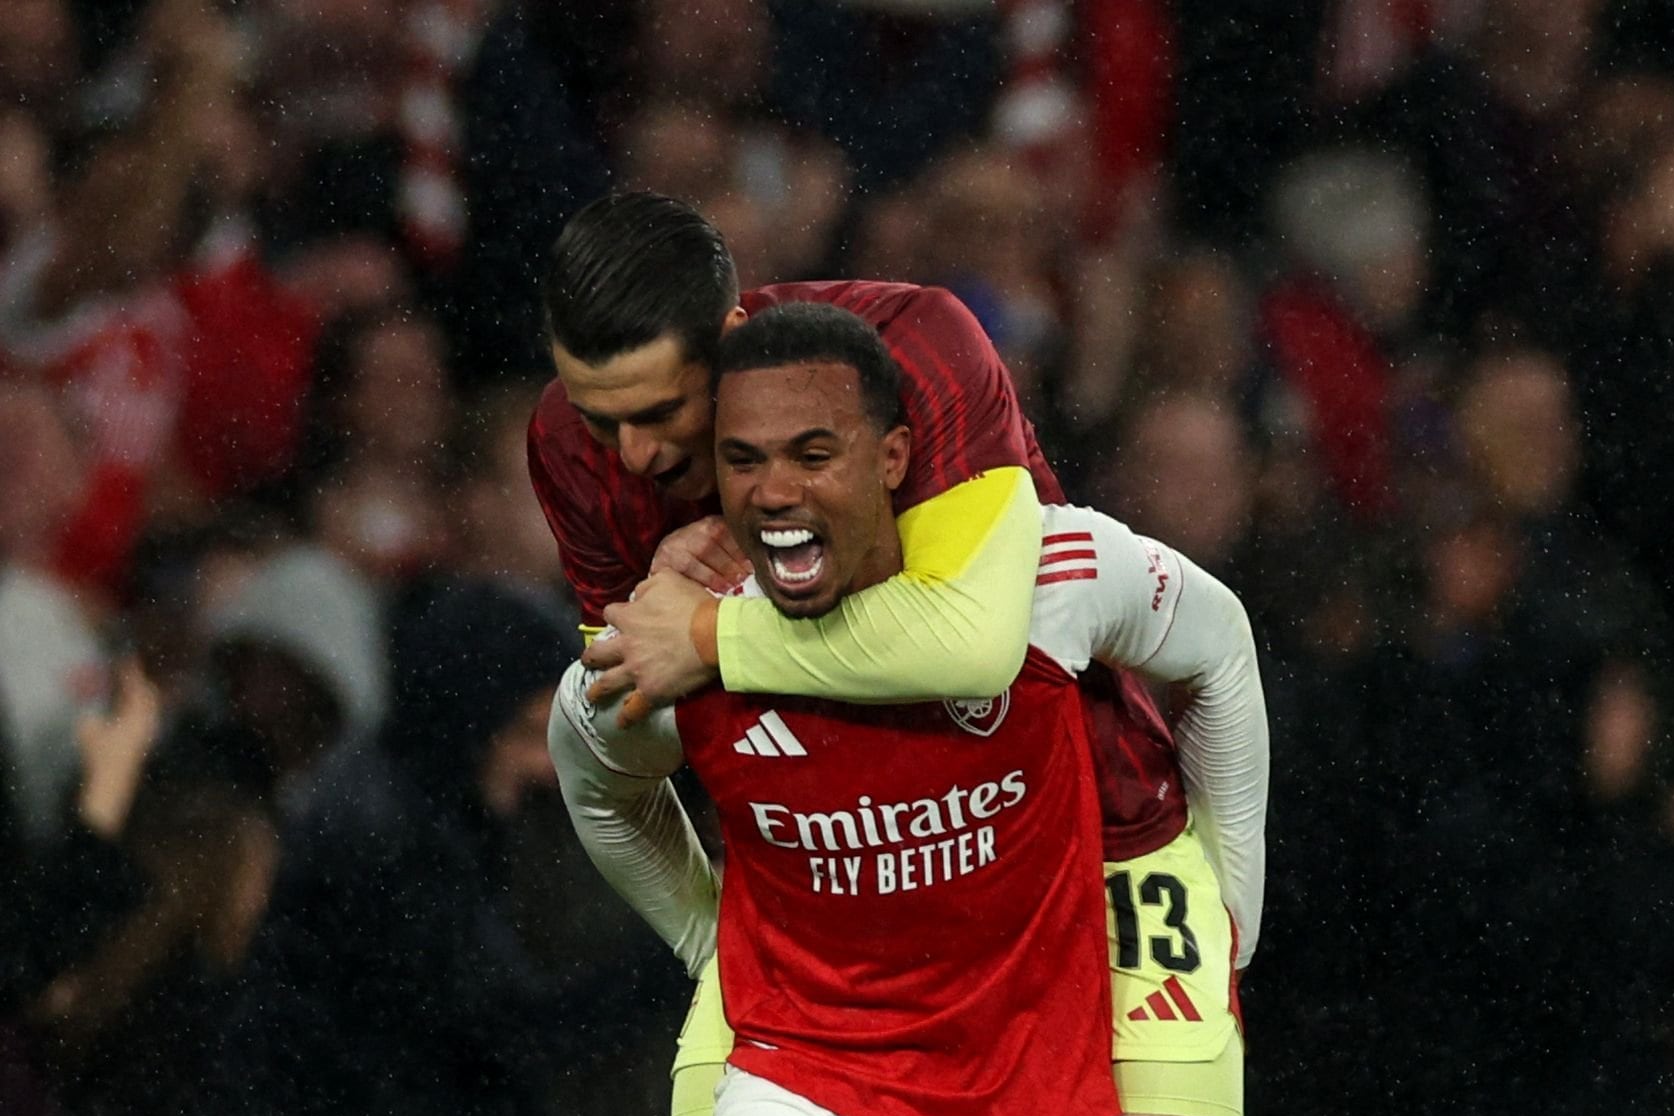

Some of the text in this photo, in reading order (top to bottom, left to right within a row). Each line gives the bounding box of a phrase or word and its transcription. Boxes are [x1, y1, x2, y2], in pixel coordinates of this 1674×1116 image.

[748, 769, 1026, 850] Emirates
[809, 825, 997, 896] FLY BETTER
[1104, 869, 1202, 975] 13
